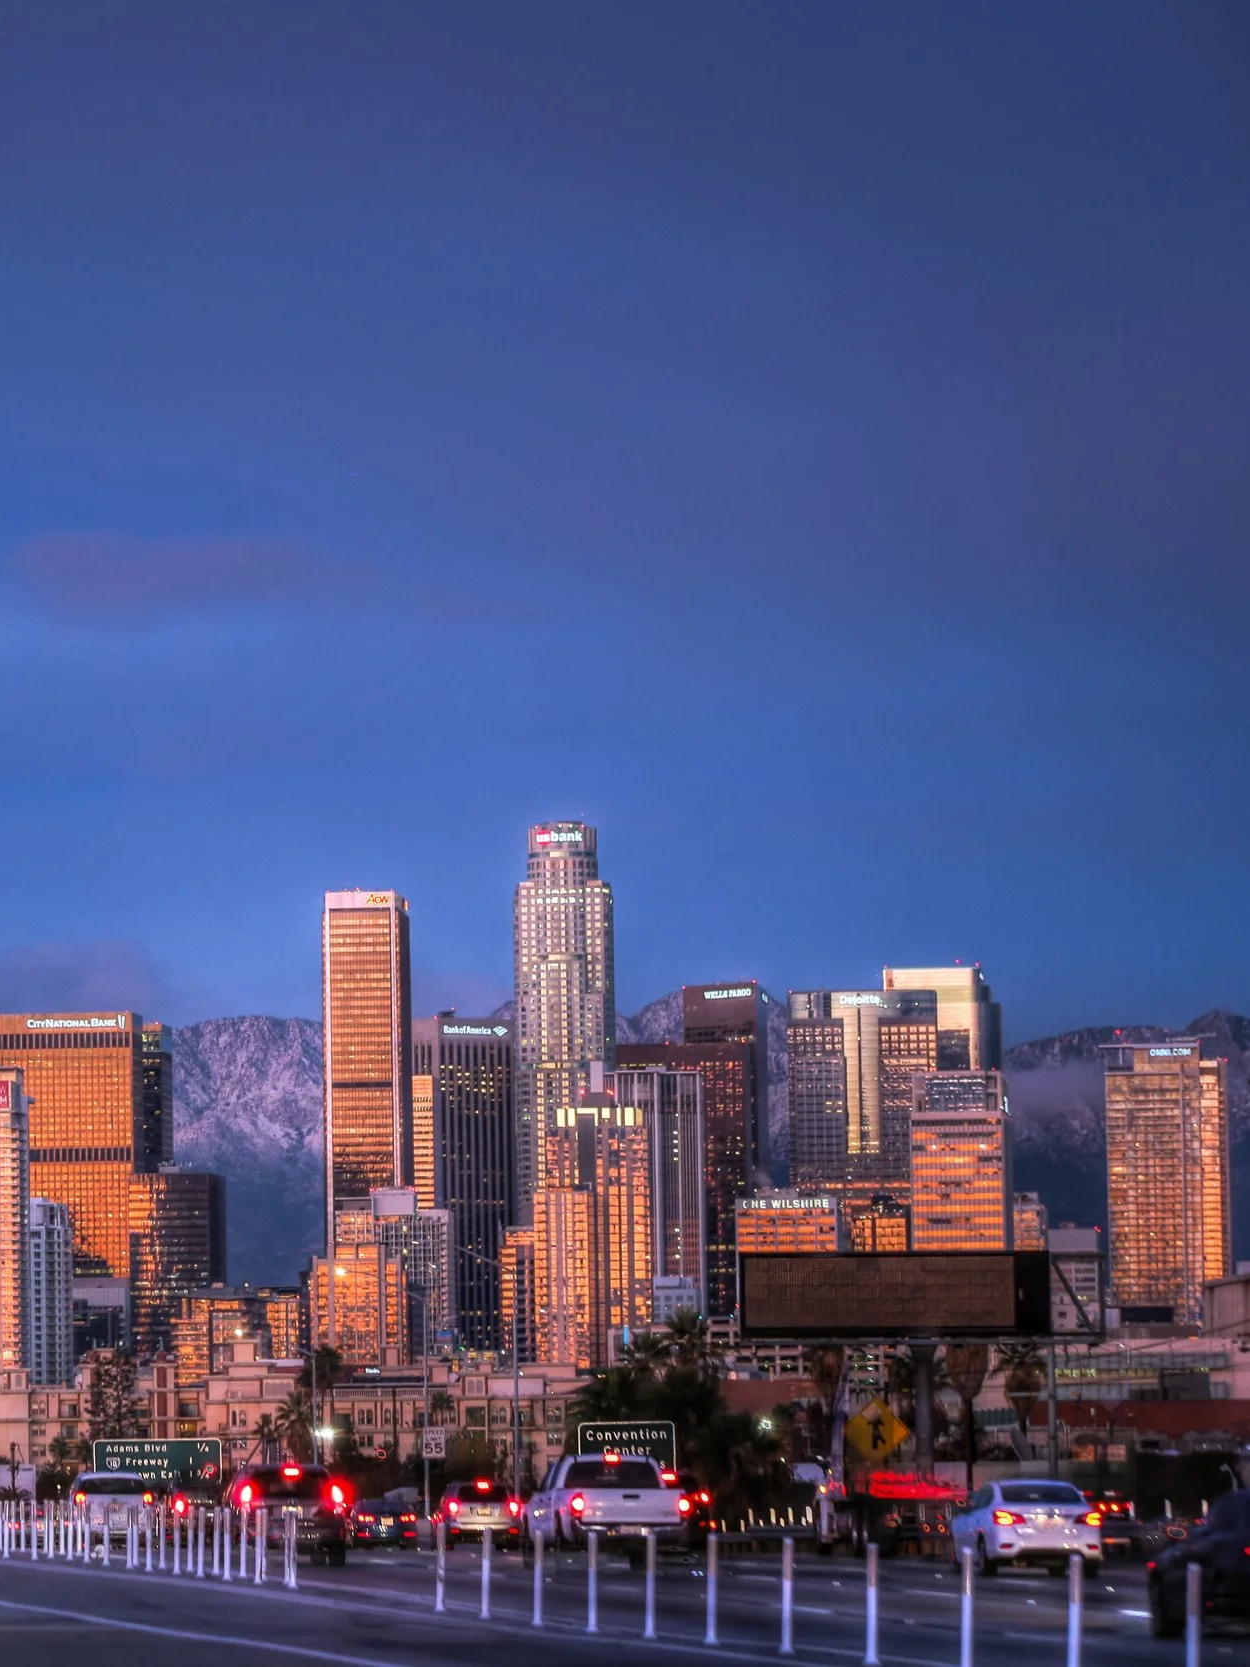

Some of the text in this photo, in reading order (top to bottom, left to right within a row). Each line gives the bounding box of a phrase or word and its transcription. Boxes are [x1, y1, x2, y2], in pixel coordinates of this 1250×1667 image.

[704, 988, 752, 999] WELLS FARGO
[443, 1025, 460, 1034] Bank
[466, 1025, 492, 1035] America
[742, 1198, 830, 1209] ONE WILSHIRE
[586, 1428, 667, 1441] Convention
[106, 1444, 139, 1453] Adams
[144, 1444, 167, 1453] Blvd
[424, 1442, 443, 1454] 55
[603, 1445, 651, 1456] Center
[125, 1457, 169, 1468] Freeway
